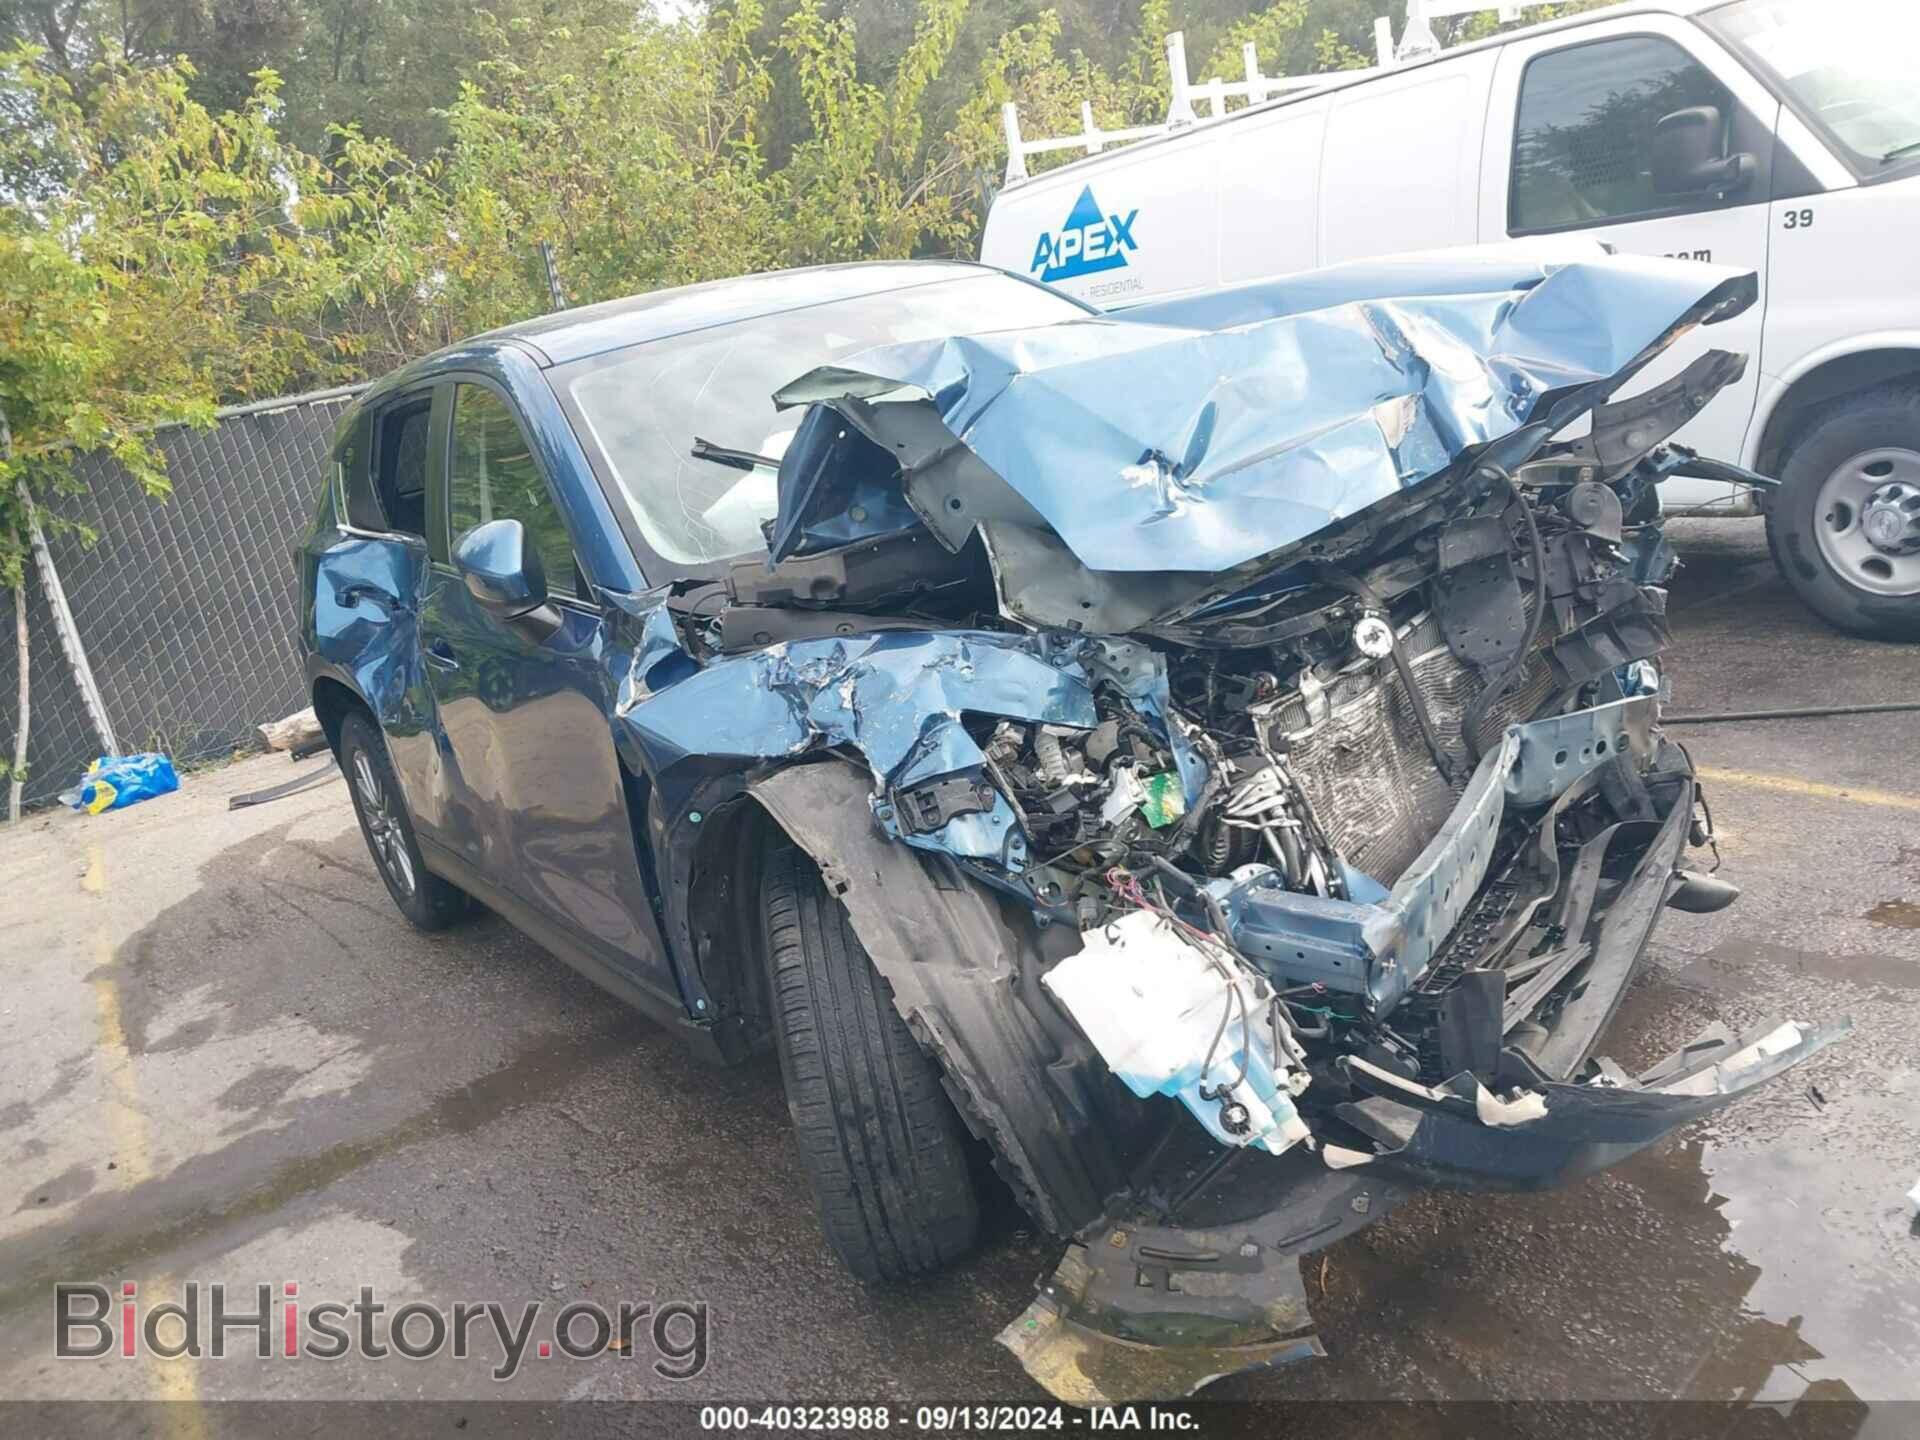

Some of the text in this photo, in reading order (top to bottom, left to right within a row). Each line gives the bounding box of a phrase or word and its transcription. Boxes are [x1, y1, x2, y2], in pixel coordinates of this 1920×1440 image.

[1783, 209, 1814, 229] 39
[1030, 208, 1140, 273] APEX
[1089, 278, 1144, 297] RESIDENTIAL
